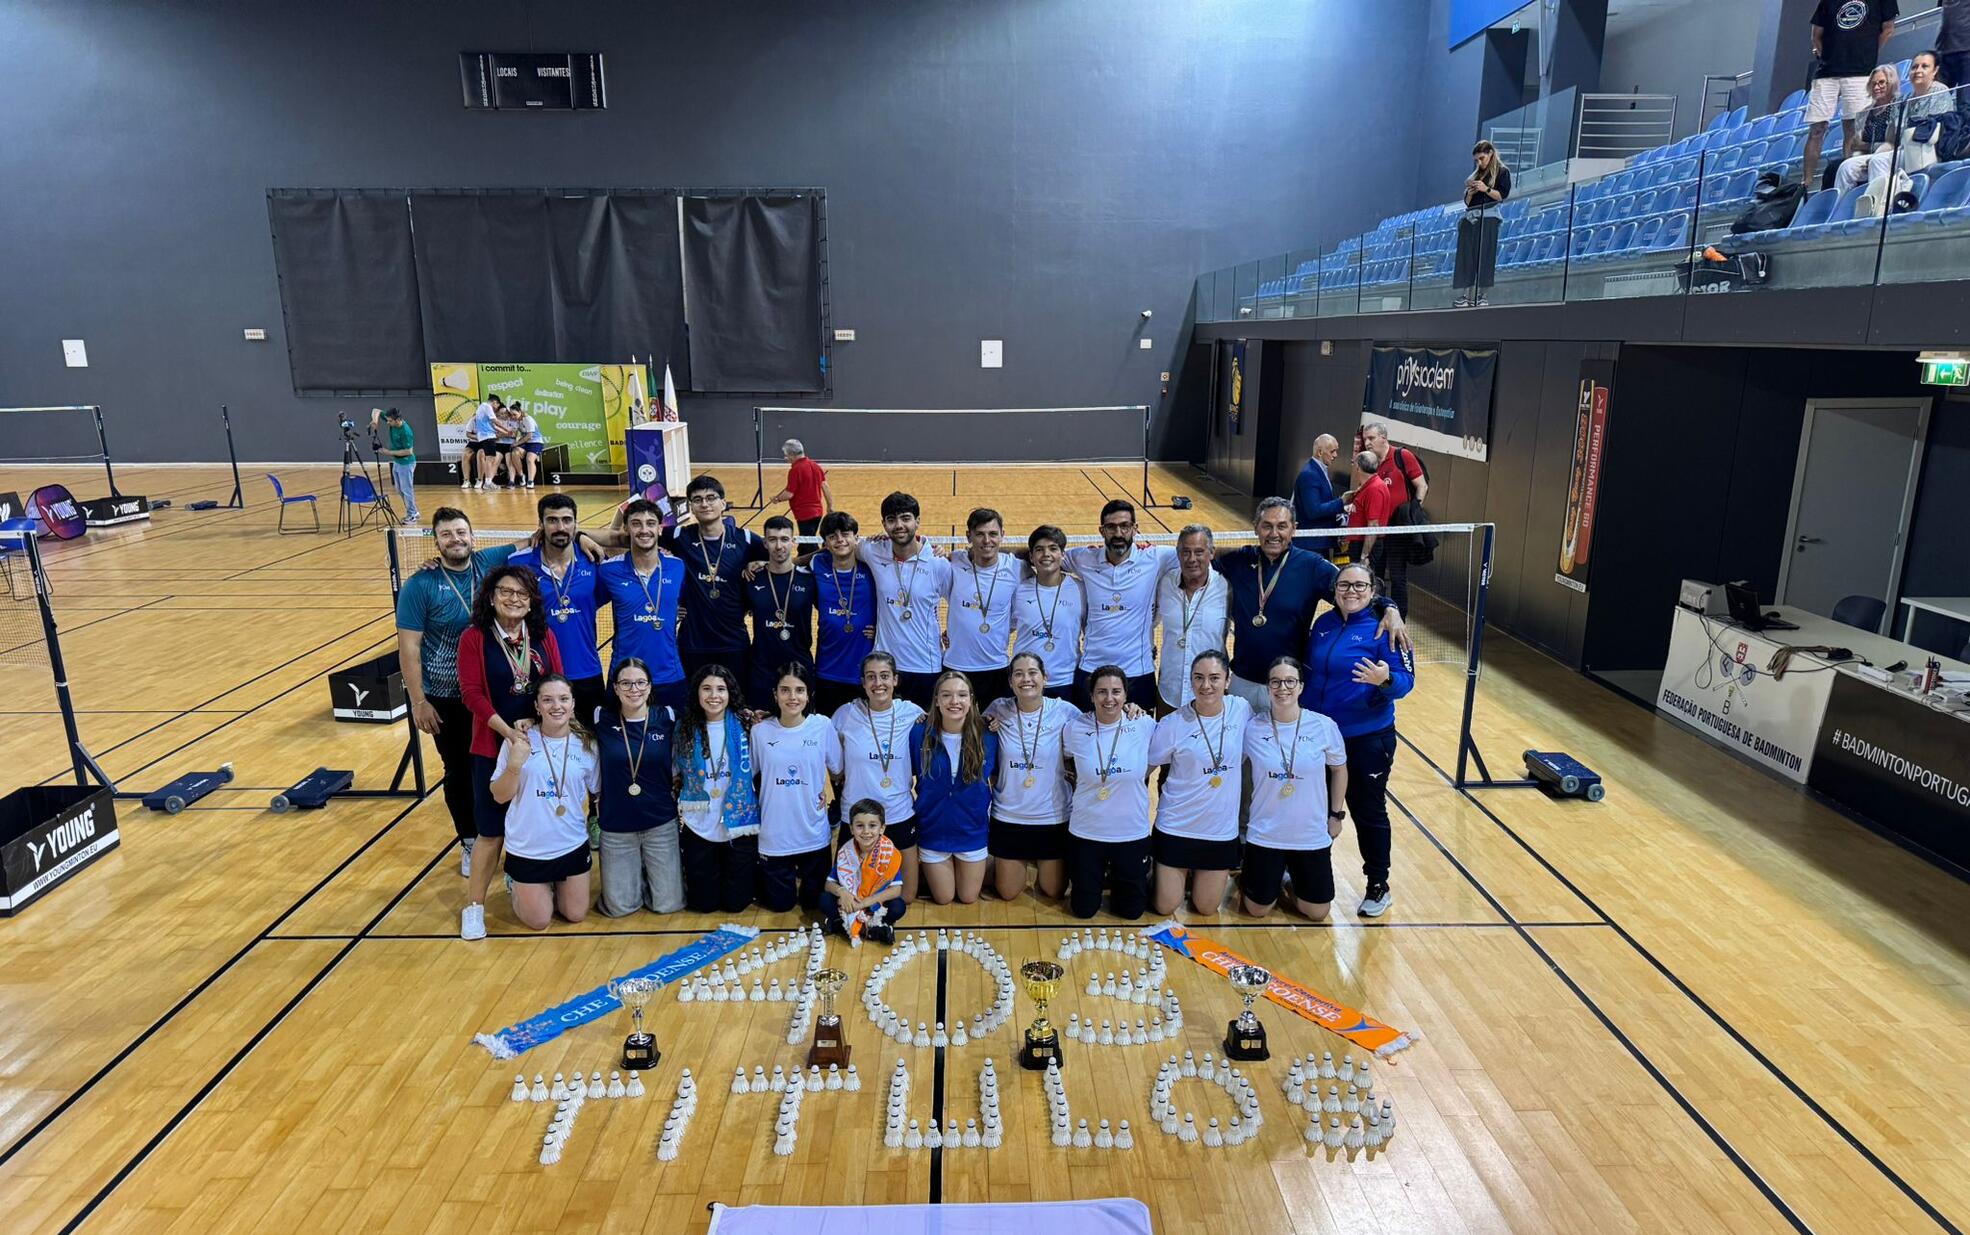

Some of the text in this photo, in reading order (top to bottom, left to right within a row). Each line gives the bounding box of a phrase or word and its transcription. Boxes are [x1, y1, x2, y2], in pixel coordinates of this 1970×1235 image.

[496, 67, 571, 77] LOCAIS VISITANTES
[1396, 356, 1455, 397] physioclem
[488, 377, 523, 391] respect
[556, 378, 574, 391] being
[534, 401, 567, 419] play
[556, 422, 601, 431] courage
[448, 464, 456, 473] 2
[1584, 424, 1601, 509] PERFORMANCE
[552, 475, 560, 484] 3
[353, 710, 374, 718] YOUNG
[1662, 688, 1802, 772] FEDERAÇÃO PORTUGUESA DE BADMINTON
[775, 777, 801, 788] Lagoa
[45, 809, 96, 859] YOUNG
[606, 951, 707, 1001] LOENSE
